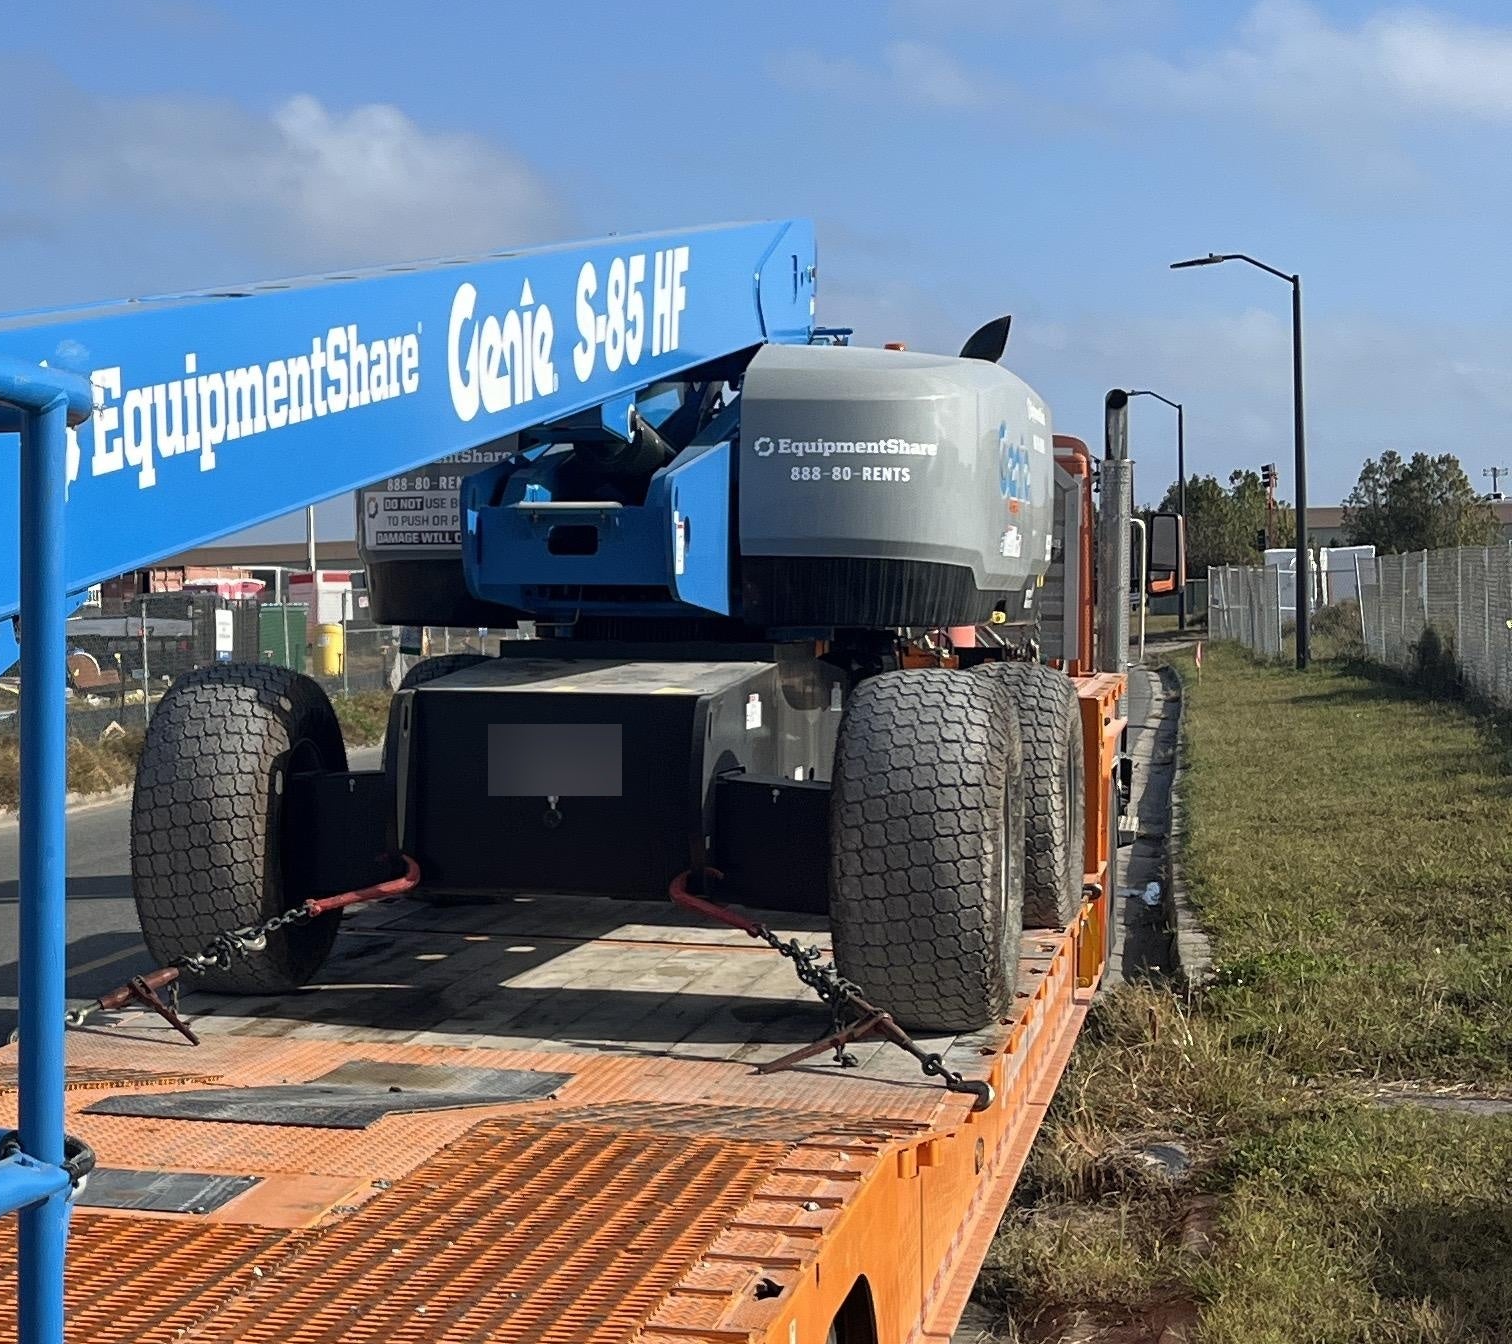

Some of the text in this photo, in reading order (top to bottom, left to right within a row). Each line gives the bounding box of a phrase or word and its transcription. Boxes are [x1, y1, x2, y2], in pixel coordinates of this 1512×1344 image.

[90, 246, 689, 489] EquipmentShare Genie S-85 HF
[777, 438, 938, 456] EquipmentShare
[790, 467, 911, 482] 888-80-RENTS
[387, 475, 463, 491] 888-80-REN
[384, 498, 399, 510] DO
[400, 498, 423, 510] NOT
[425, 498, 446, 509] USE
[387, 516, 399, 526] TO
[401, 515, 429, 526] PUSH
[432, 515, 448, 526] OR
[377, 532, 420, 544] DAMAGE
[421, 532, 452, 543] WILL
